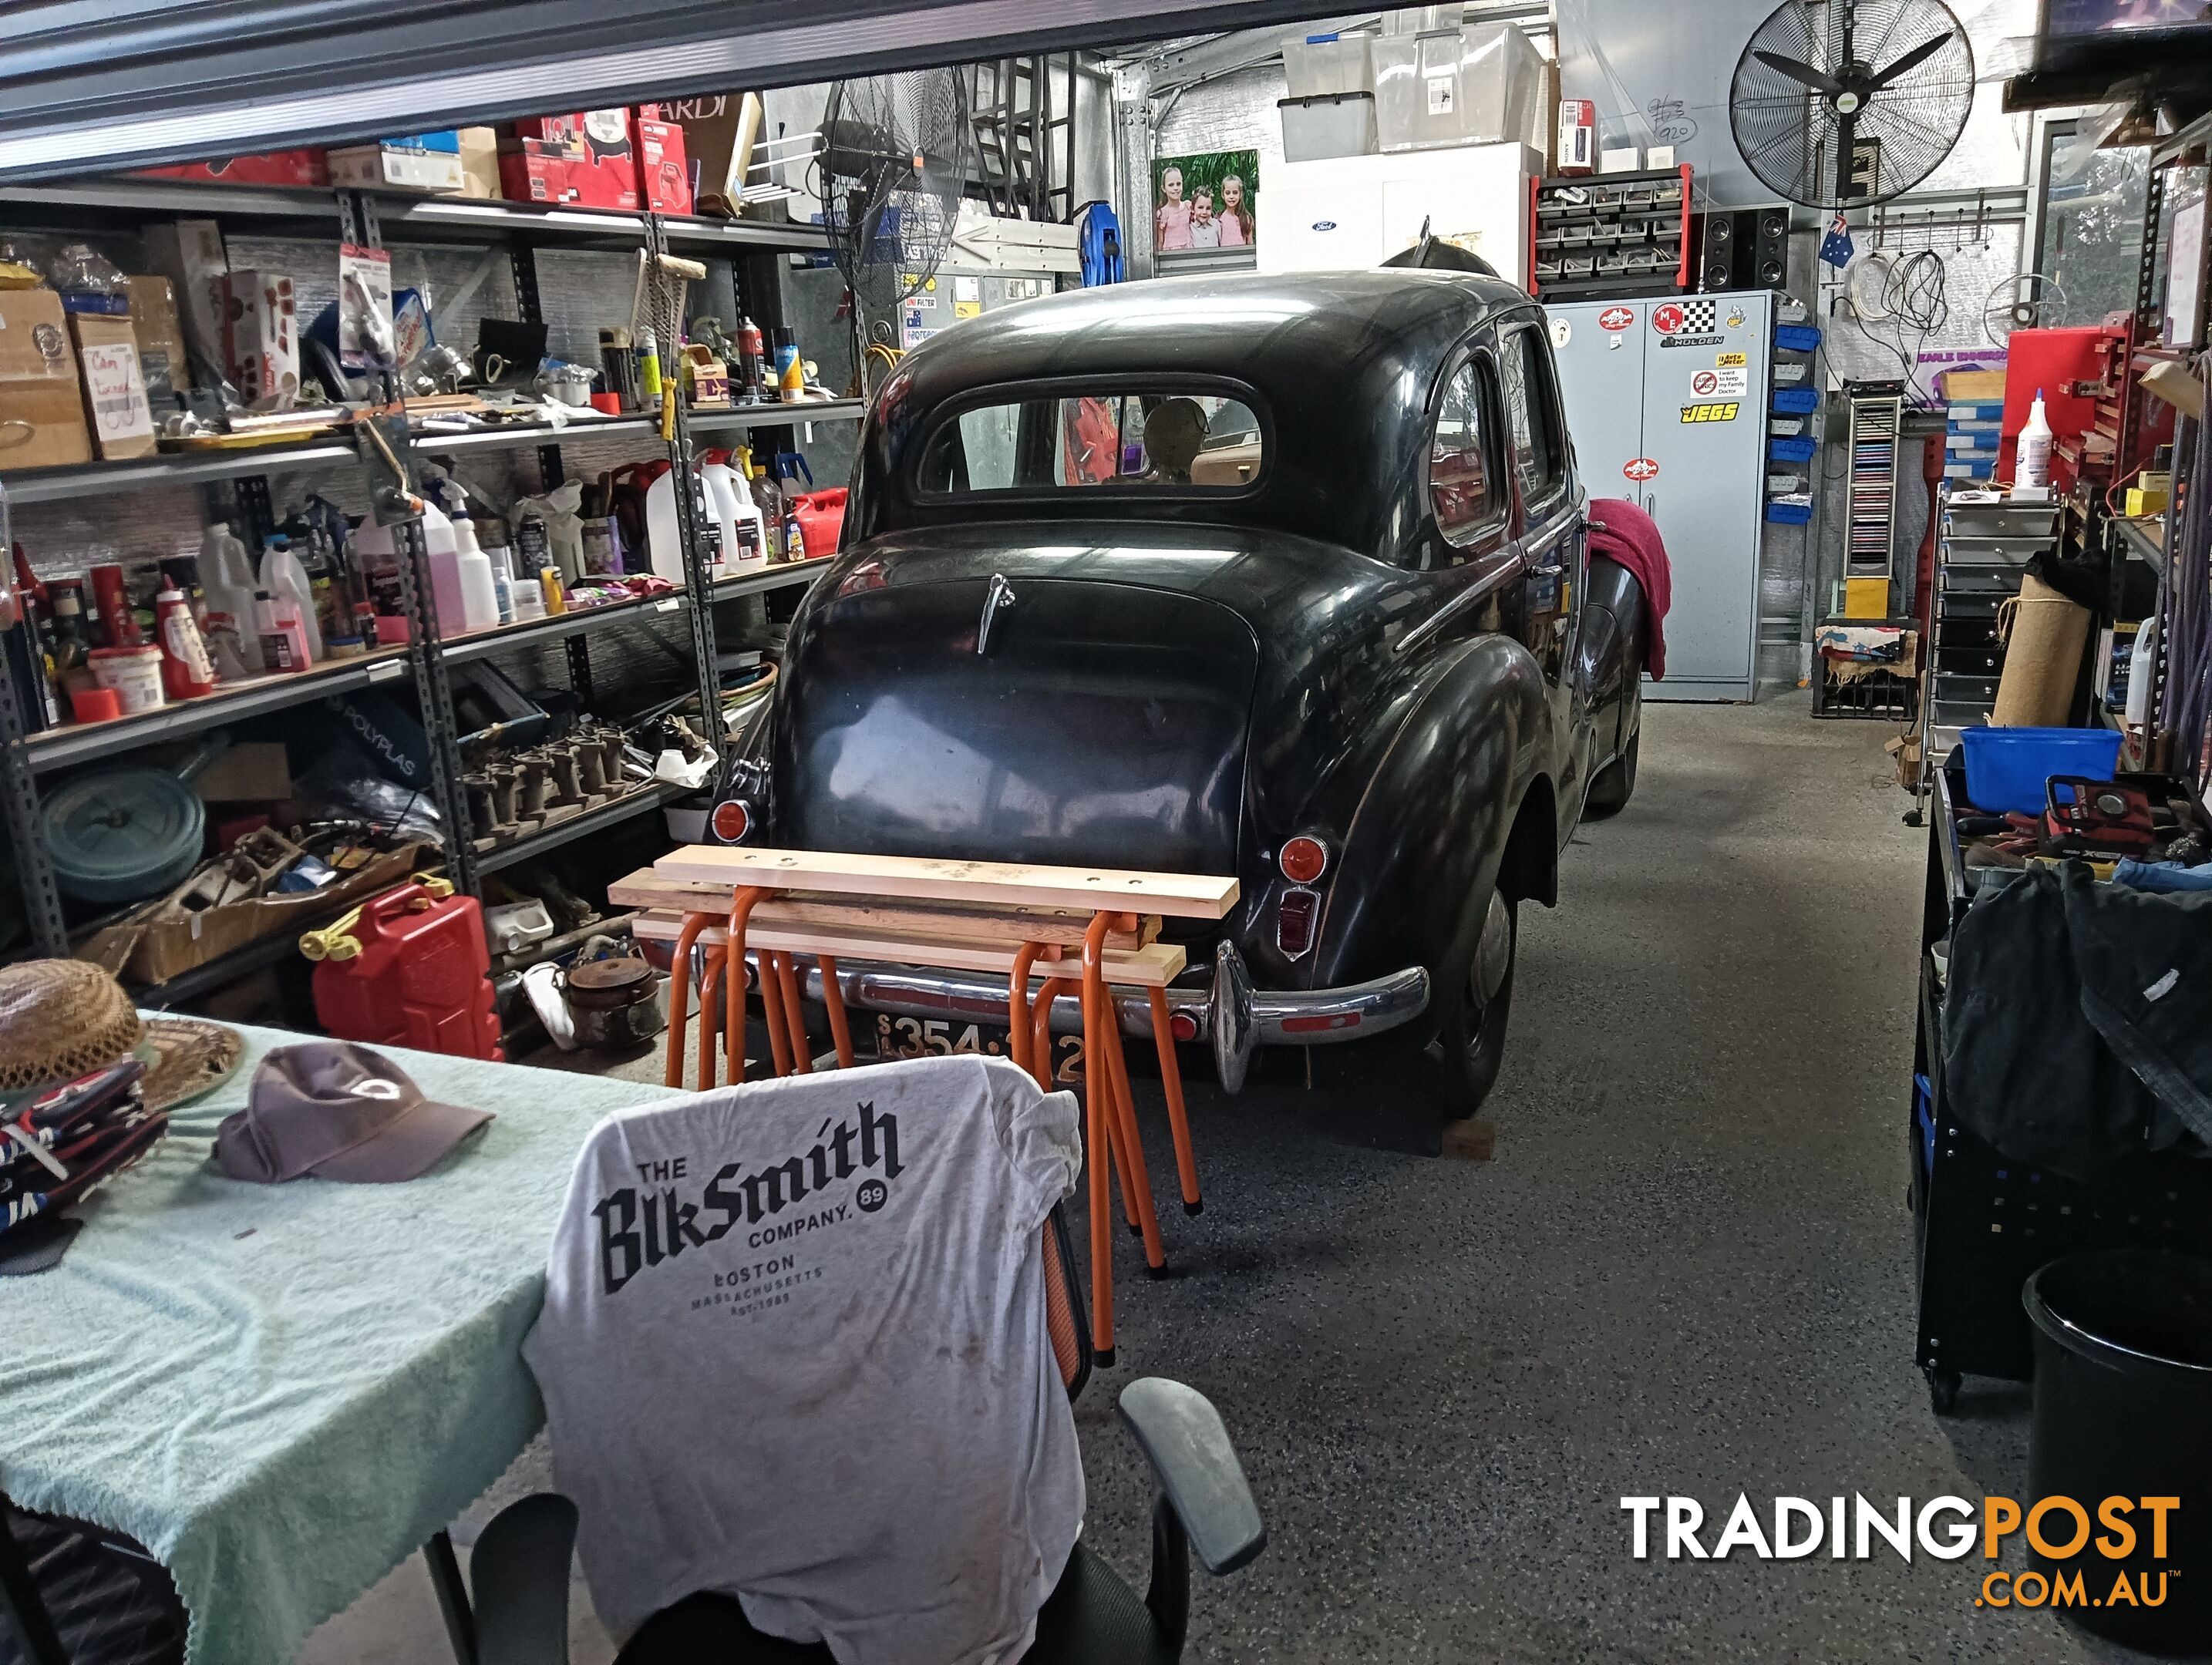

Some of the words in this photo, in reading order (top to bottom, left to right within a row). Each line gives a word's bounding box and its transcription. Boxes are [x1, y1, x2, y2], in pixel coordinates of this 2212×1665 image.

[1660, 126, 1688, 142] 920
[906, 298, 916, 307] UNI
[917, 298, 934, 308] FILTER
[1675, 336, 1724, 346] HOLDEN
[1681, 402, 1739, 423] JEGS
[637, 1157, 688, 1183] THE
[591, 1101, 905, 1296] BlkSmith
[860, 1187, 884, 1205] 89
[748, 1205, 852, 1249] COMPANY.
